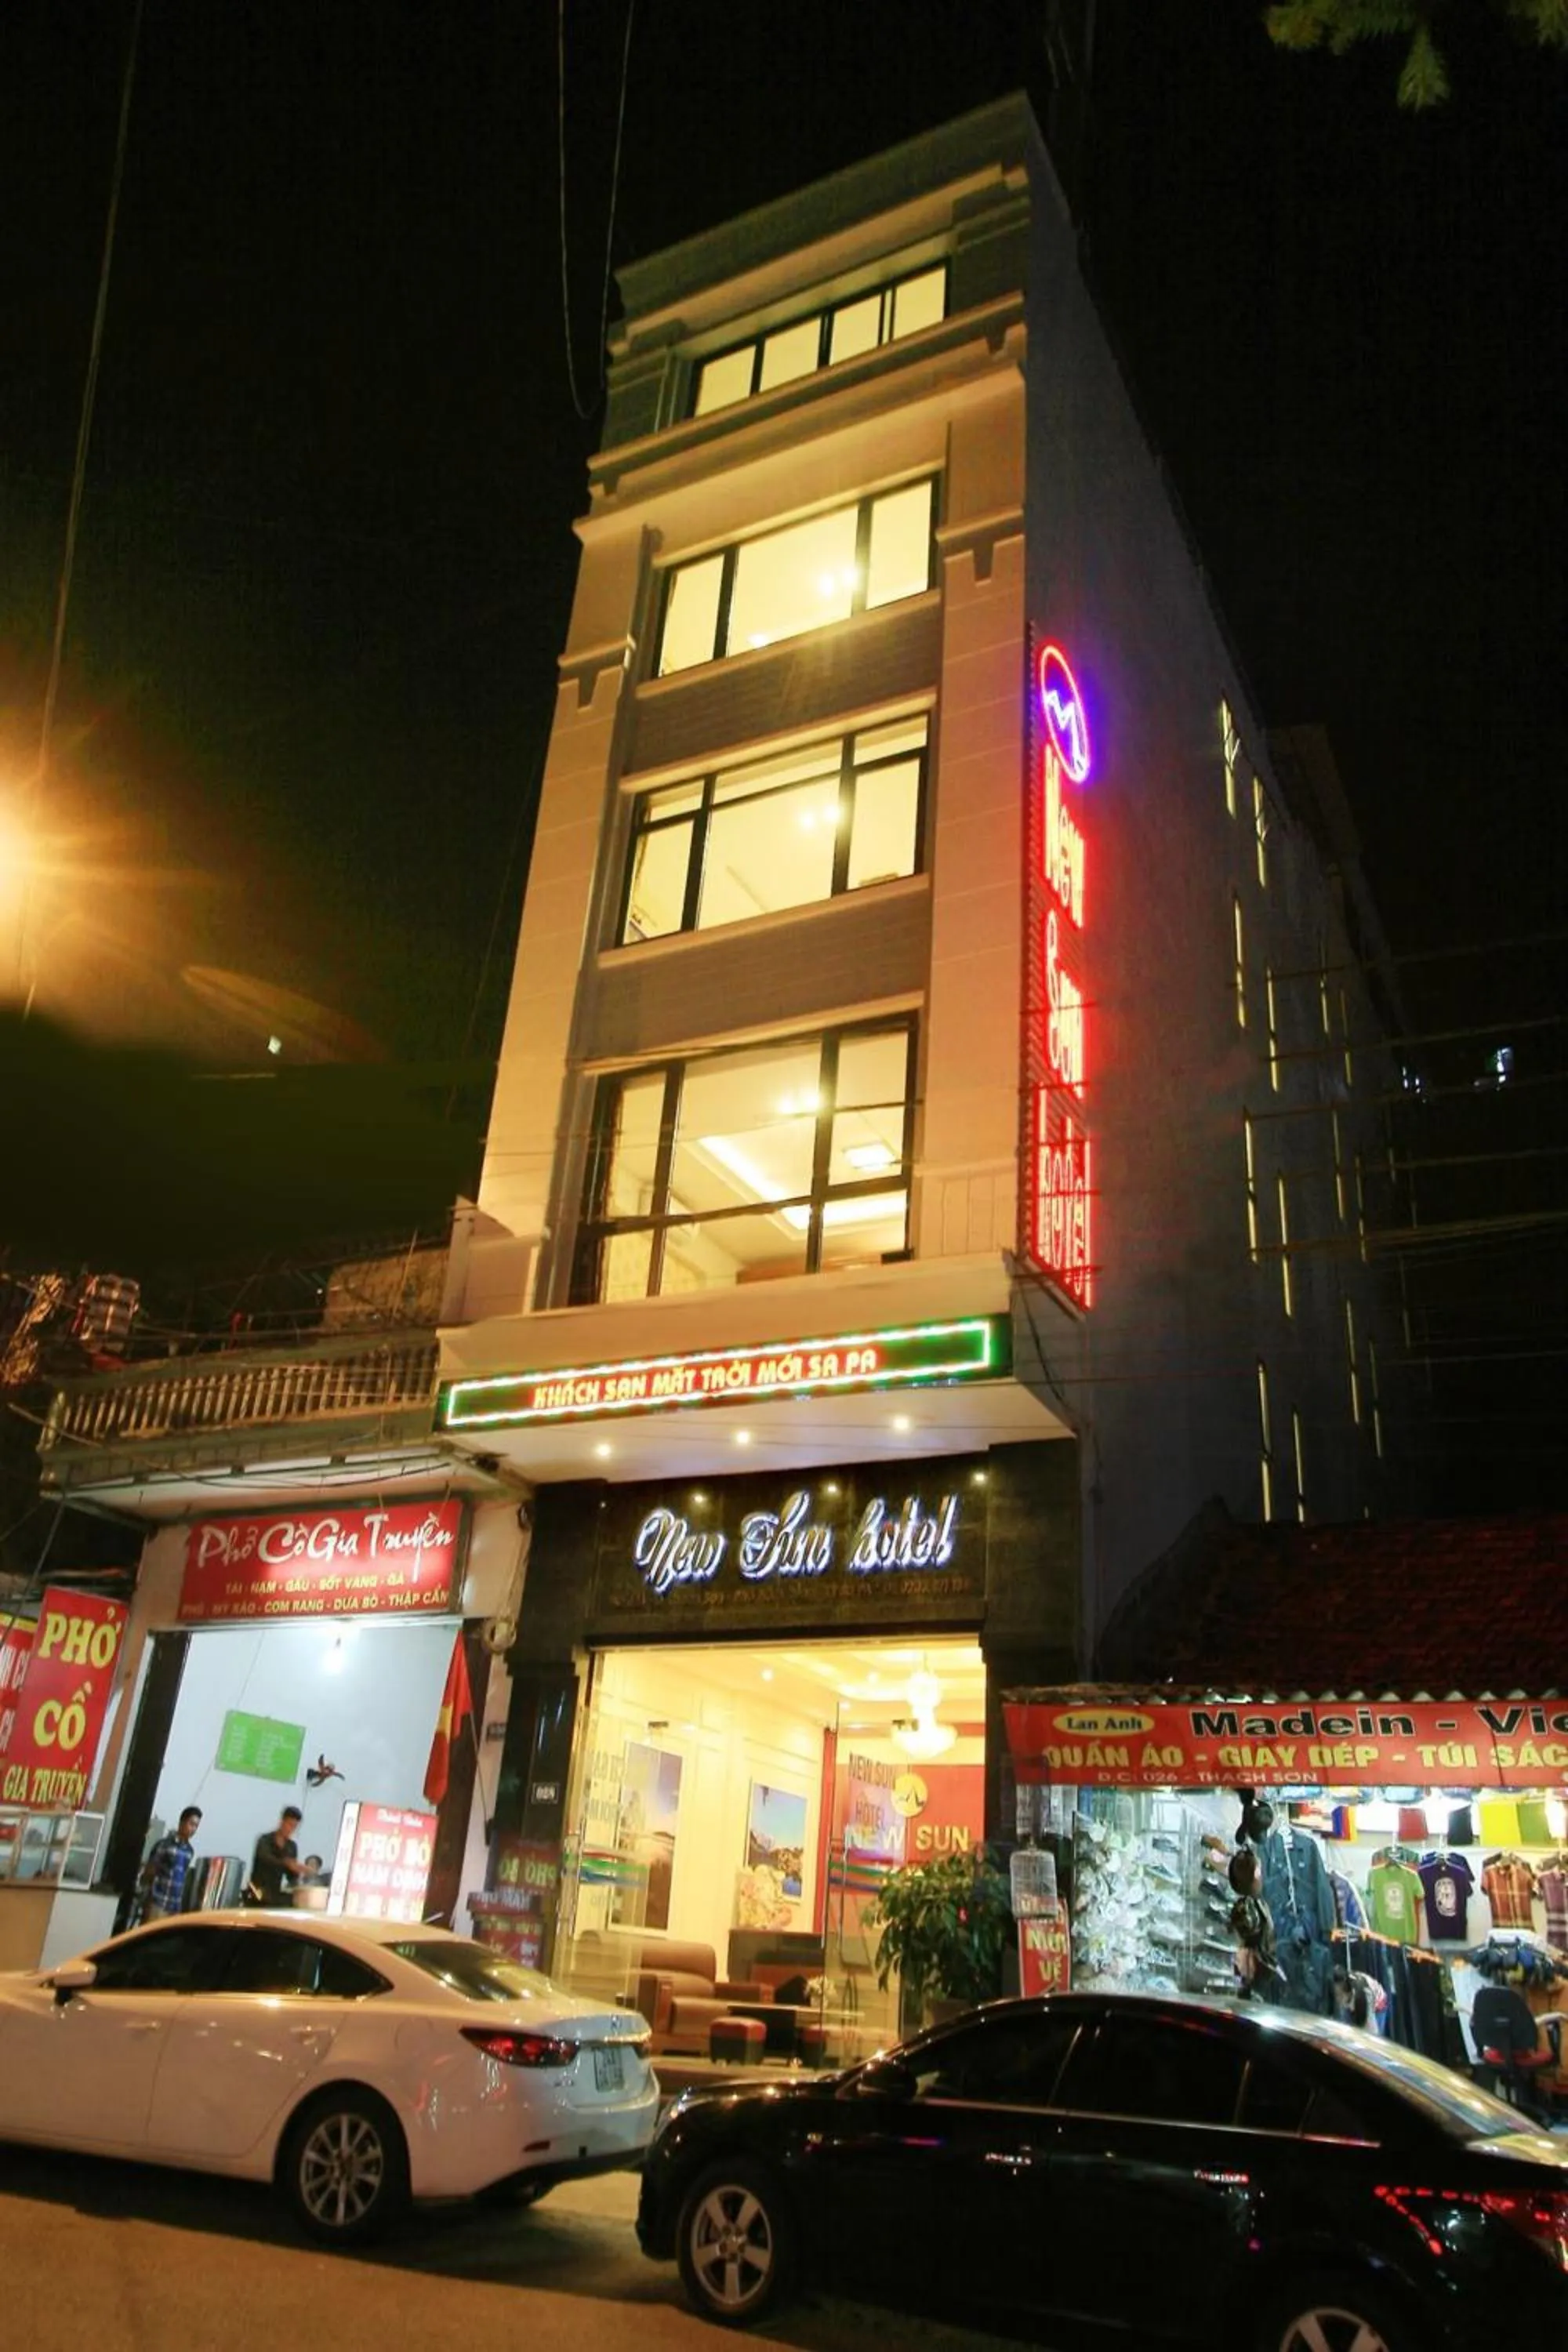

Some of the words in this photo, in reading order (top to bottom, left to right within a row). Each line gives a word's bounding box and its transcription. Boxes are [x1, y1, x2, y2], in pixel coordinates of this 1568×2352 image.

[532, 1379, 601, 1409] KHÁCH
[756, 1353, 803, 1385] MỚI
[808, 1354, 838, 1380] SA
[845, 1348, 877, 1374] PA
[633, 1508, 728, 1595] New
[739, 1490, 833, 1579] Sun
[38, 1606, 122, 1669] PHỞ
[33, 1681, 93, 1751] CỒ
[1066, 1717, 1098, 1731] Lan
[1104, 1716, 1143, 1731] Anh
[1189, 1708, 1416, 1738] Madein
[1307, 1741, 1379, 1768] DÉP
[1416, 1741, 1478, 1768] TÚI
[2, 1764, 29, 1802] GIA
[916, 1824, 970, 1852] SUN
